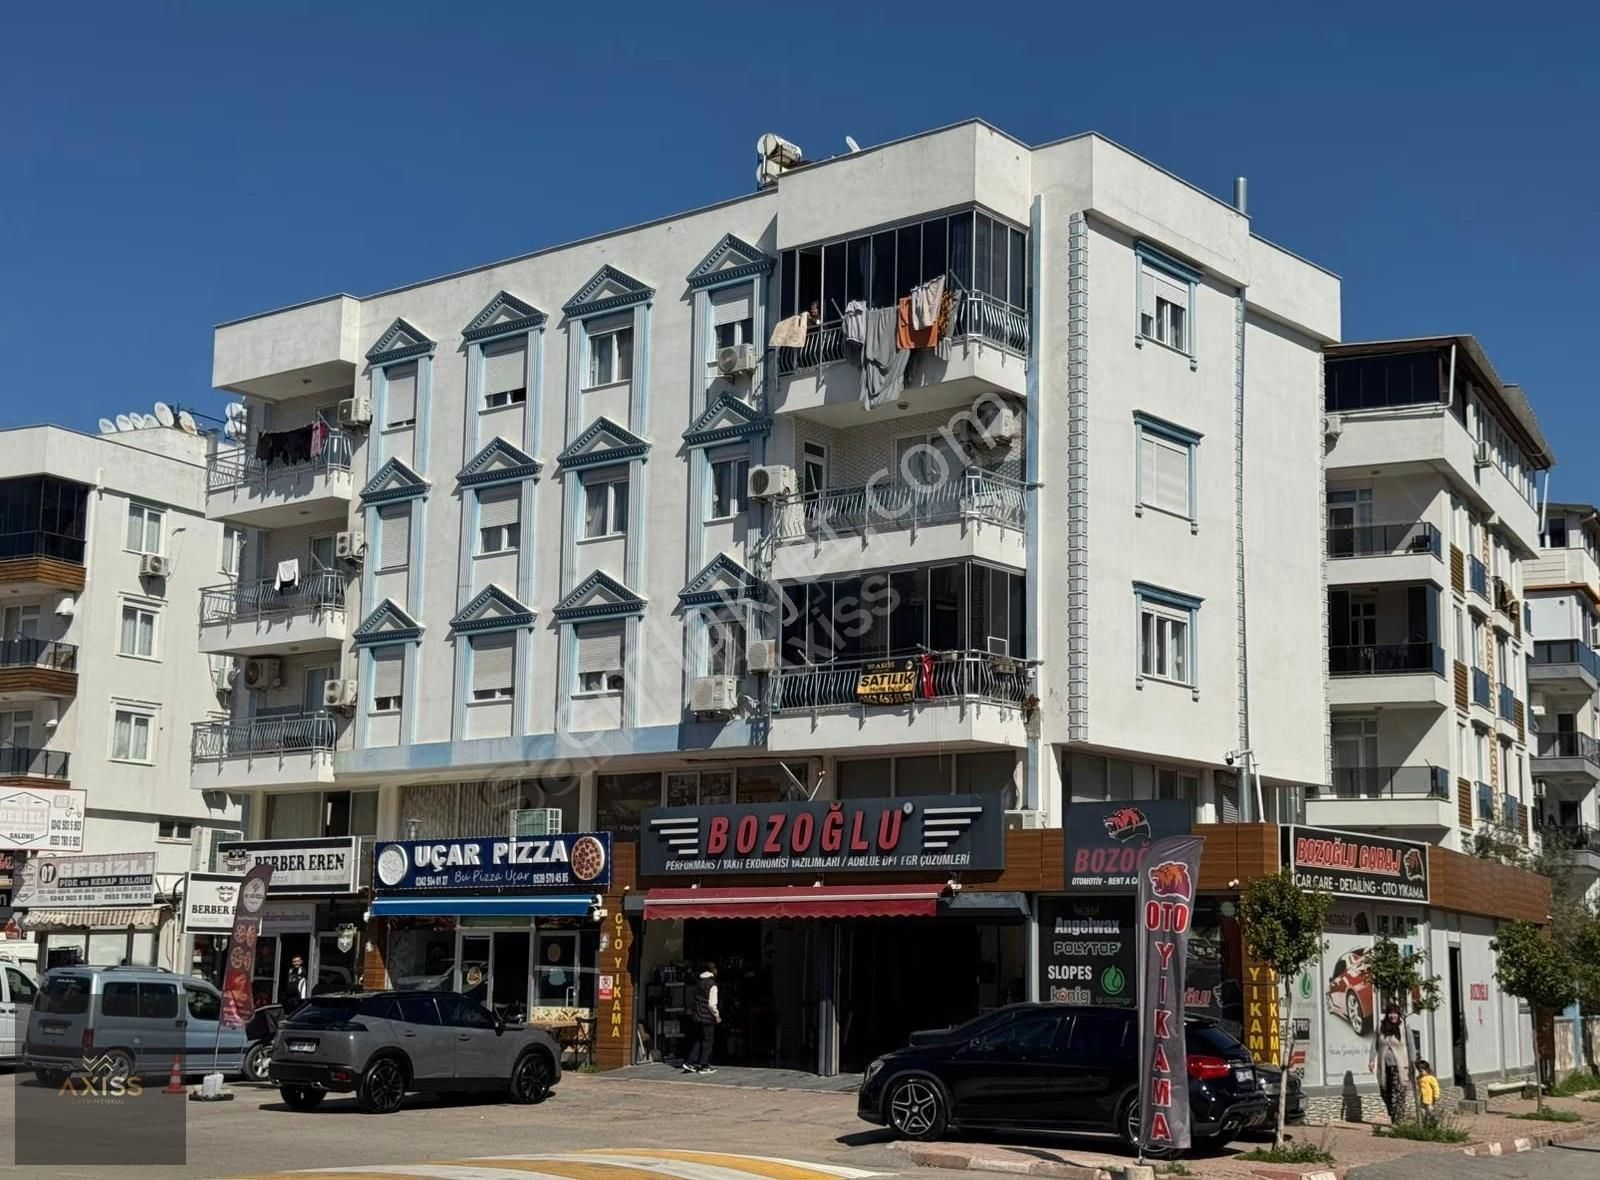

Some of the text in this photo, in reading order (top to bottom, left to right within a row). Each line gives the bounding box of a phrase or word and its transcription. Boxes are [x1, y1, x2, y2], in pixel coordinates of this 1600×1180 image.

[861, 672, 914, 687] SATILIK
[707, 802, 903, 854] BOZOĞLU
[255, 853, 345, 872] BERBER EREN
[414, 837, 568, 872] UÇAR PİZZA
[665, 859, 716, 871] PERFORMANS
[745, 856, 789, 869] EKONOMİSİ
[791, 856, 841, 868] YAZILIMLARI
[848, 855, 880, 866] ADBLUE
[901, 855, 918, 866] EGR
[1296, 837, 1401, 873] BOZOĞLU GARAJ
[41, 865, 54, 882] 07
[90, 877, 117, 886] KEBAP
[119, 876, 151, 885] SALONU
[454, 869, 530, 884] Bu Pizza Uçar
[1071, 875, 1103, 885] OTOMOTİV
[1107, 876, 1124, 885] RENT
[1296, 873, 1311, 888] CAR
[1313, 876, 1333, 890] CARE
[1382, 882, 1398, 896] OTO
[1398, 884, 1424, 899] YIKAMA
[192, 904, 229, 914] BERBER
[1145, 901, 1190, 934] OTO
[614, 912, 623, 950] OTO
[1054, 916, 1120, 935] Angelwax
[1053, 941, 1119, 956] POLYTOP
[1047, 965, 1093, 980] SLOPES
[1151, 942, 1174, 1141] YIKAMA
